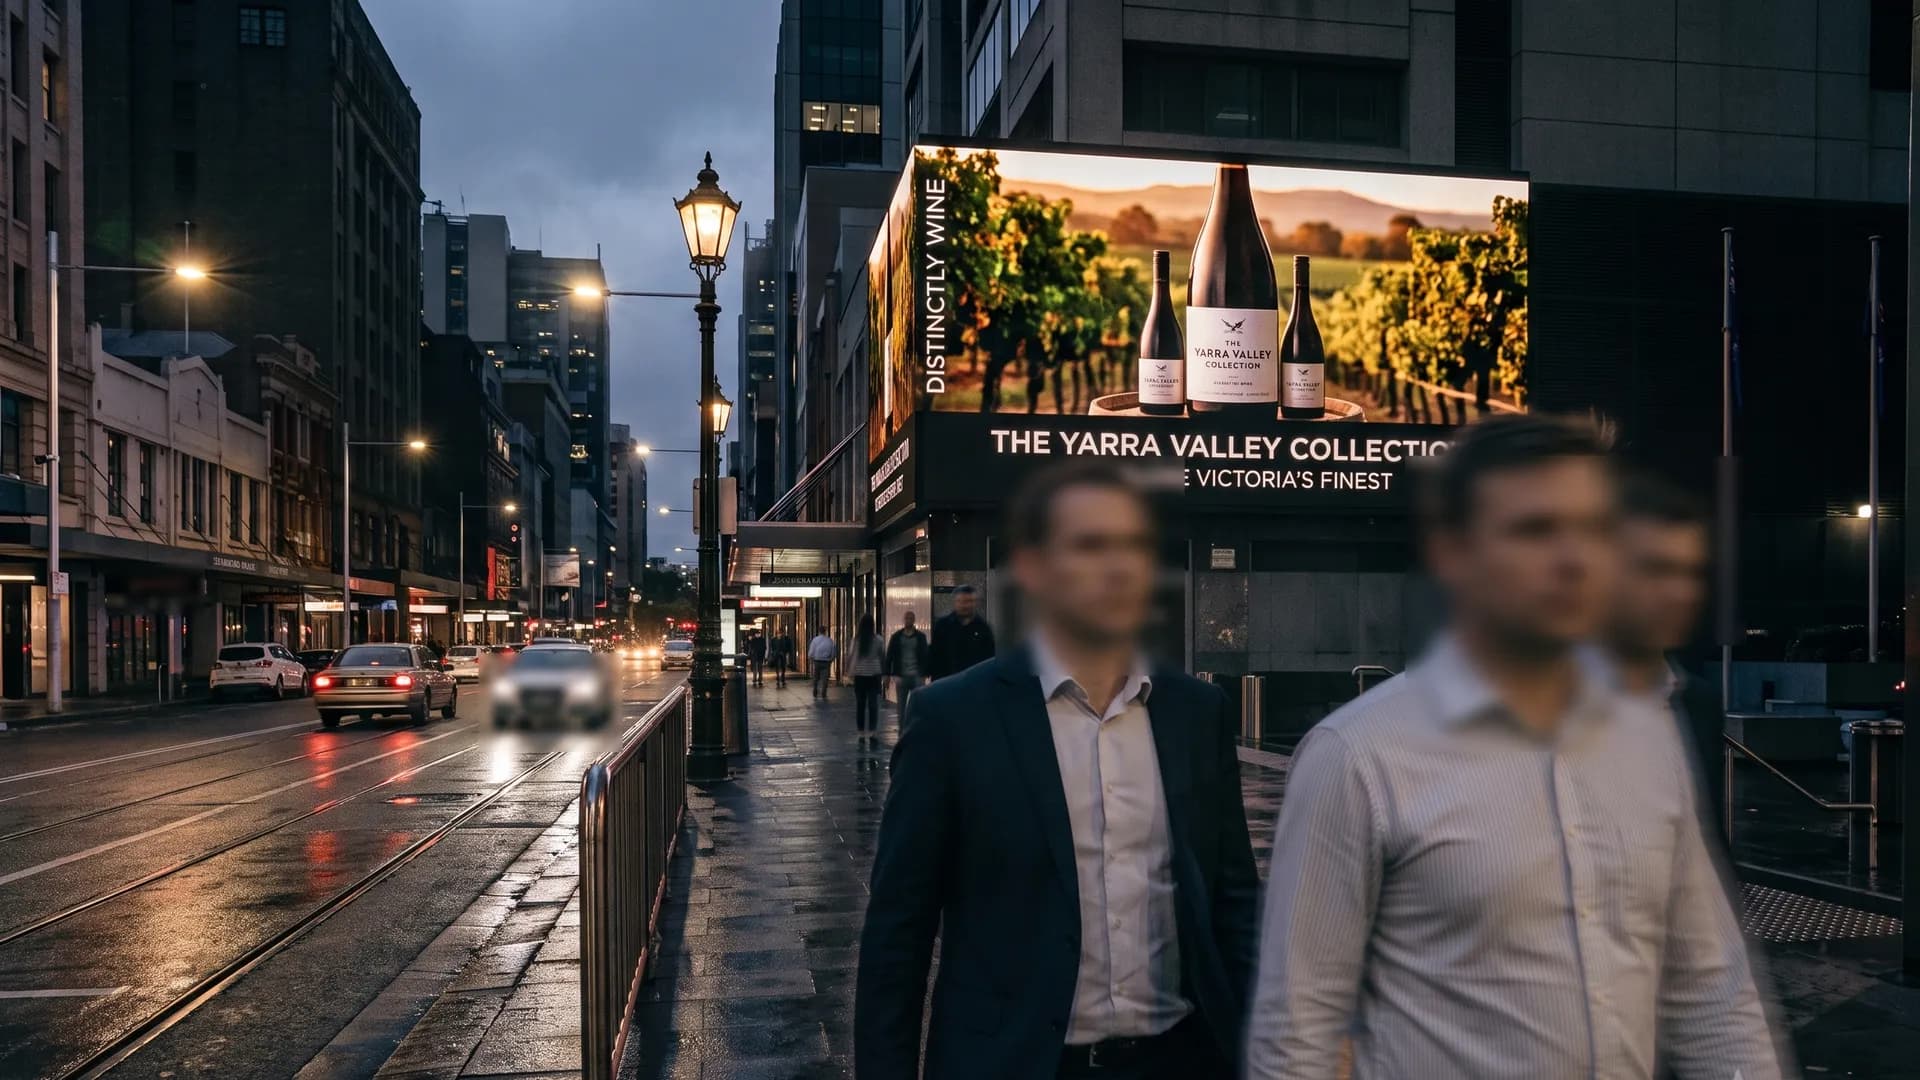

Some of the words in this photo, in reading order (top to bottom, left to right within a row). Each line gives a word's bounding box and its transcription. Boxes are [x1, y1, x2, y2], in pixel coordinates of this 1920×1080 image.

[926, 179, 945, 246] WINE
[926, 253, 945, 393] DISTINCTLY
[1195, 348, 1230, 359] YARRA
[1232, 349, 1272, 360] VALLEY
[1205, 361, 1261, 369] COLLECTION
[990, 430, 1051, 454] THE
[1059, 431, 1162, 457] YARRA
[1169, 434, 1282, 460] VALLEY
[1196, 468, 1314, 489] VICTORIA’S
[1320, 471, 1393, 490] FINEST
